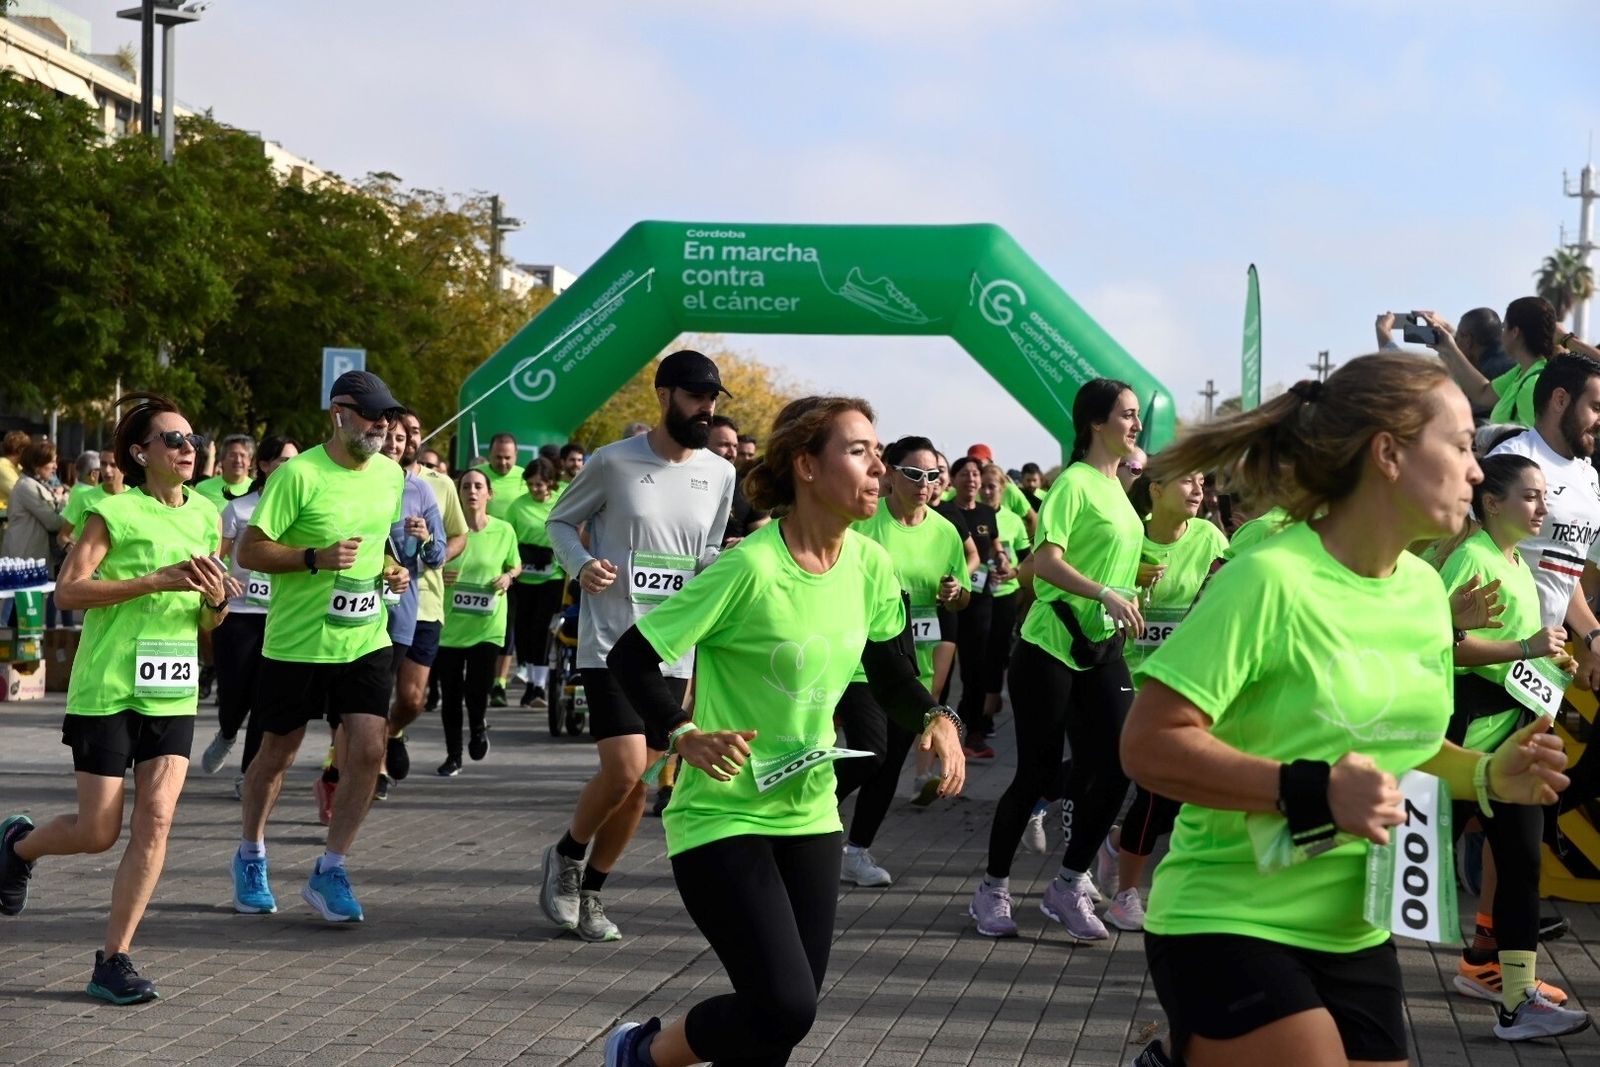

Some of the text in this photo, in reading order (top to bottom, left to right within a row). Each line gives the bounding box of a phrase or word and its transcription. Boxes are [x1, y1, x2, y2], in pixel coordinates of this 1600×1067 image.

[686, 229, 746, 239] Córdoba
[684, 241, 817, 262] En marcha
[682, 266, 765, 287] contra
[682, 290, 800, 311] el cáncer
[552, 333, 584, 362] contra
[583, 322, 594, 335] el
[1020, 321, 1051, 352] contra
[1049, 350, 1063, 361] el
[1030, 312, 1079, 359] asociación
[562, 323, 617, 372] en Córdoba
[333, 356, 354, 381] P
[1023, 343, 1063, 383] Córdoba
[250, 583, 269, 595] 03
[634, 572, 684, 591] 0278
[332, 595, 375, 612] 0124
[454, 594, 489, 607] 0378
[912, 622, 930, 636] 17
[140, 662, 190, 680] 0123
[1512, 662, 1552, 703] 0223
[1401, 798, 1429, 930] 0007
